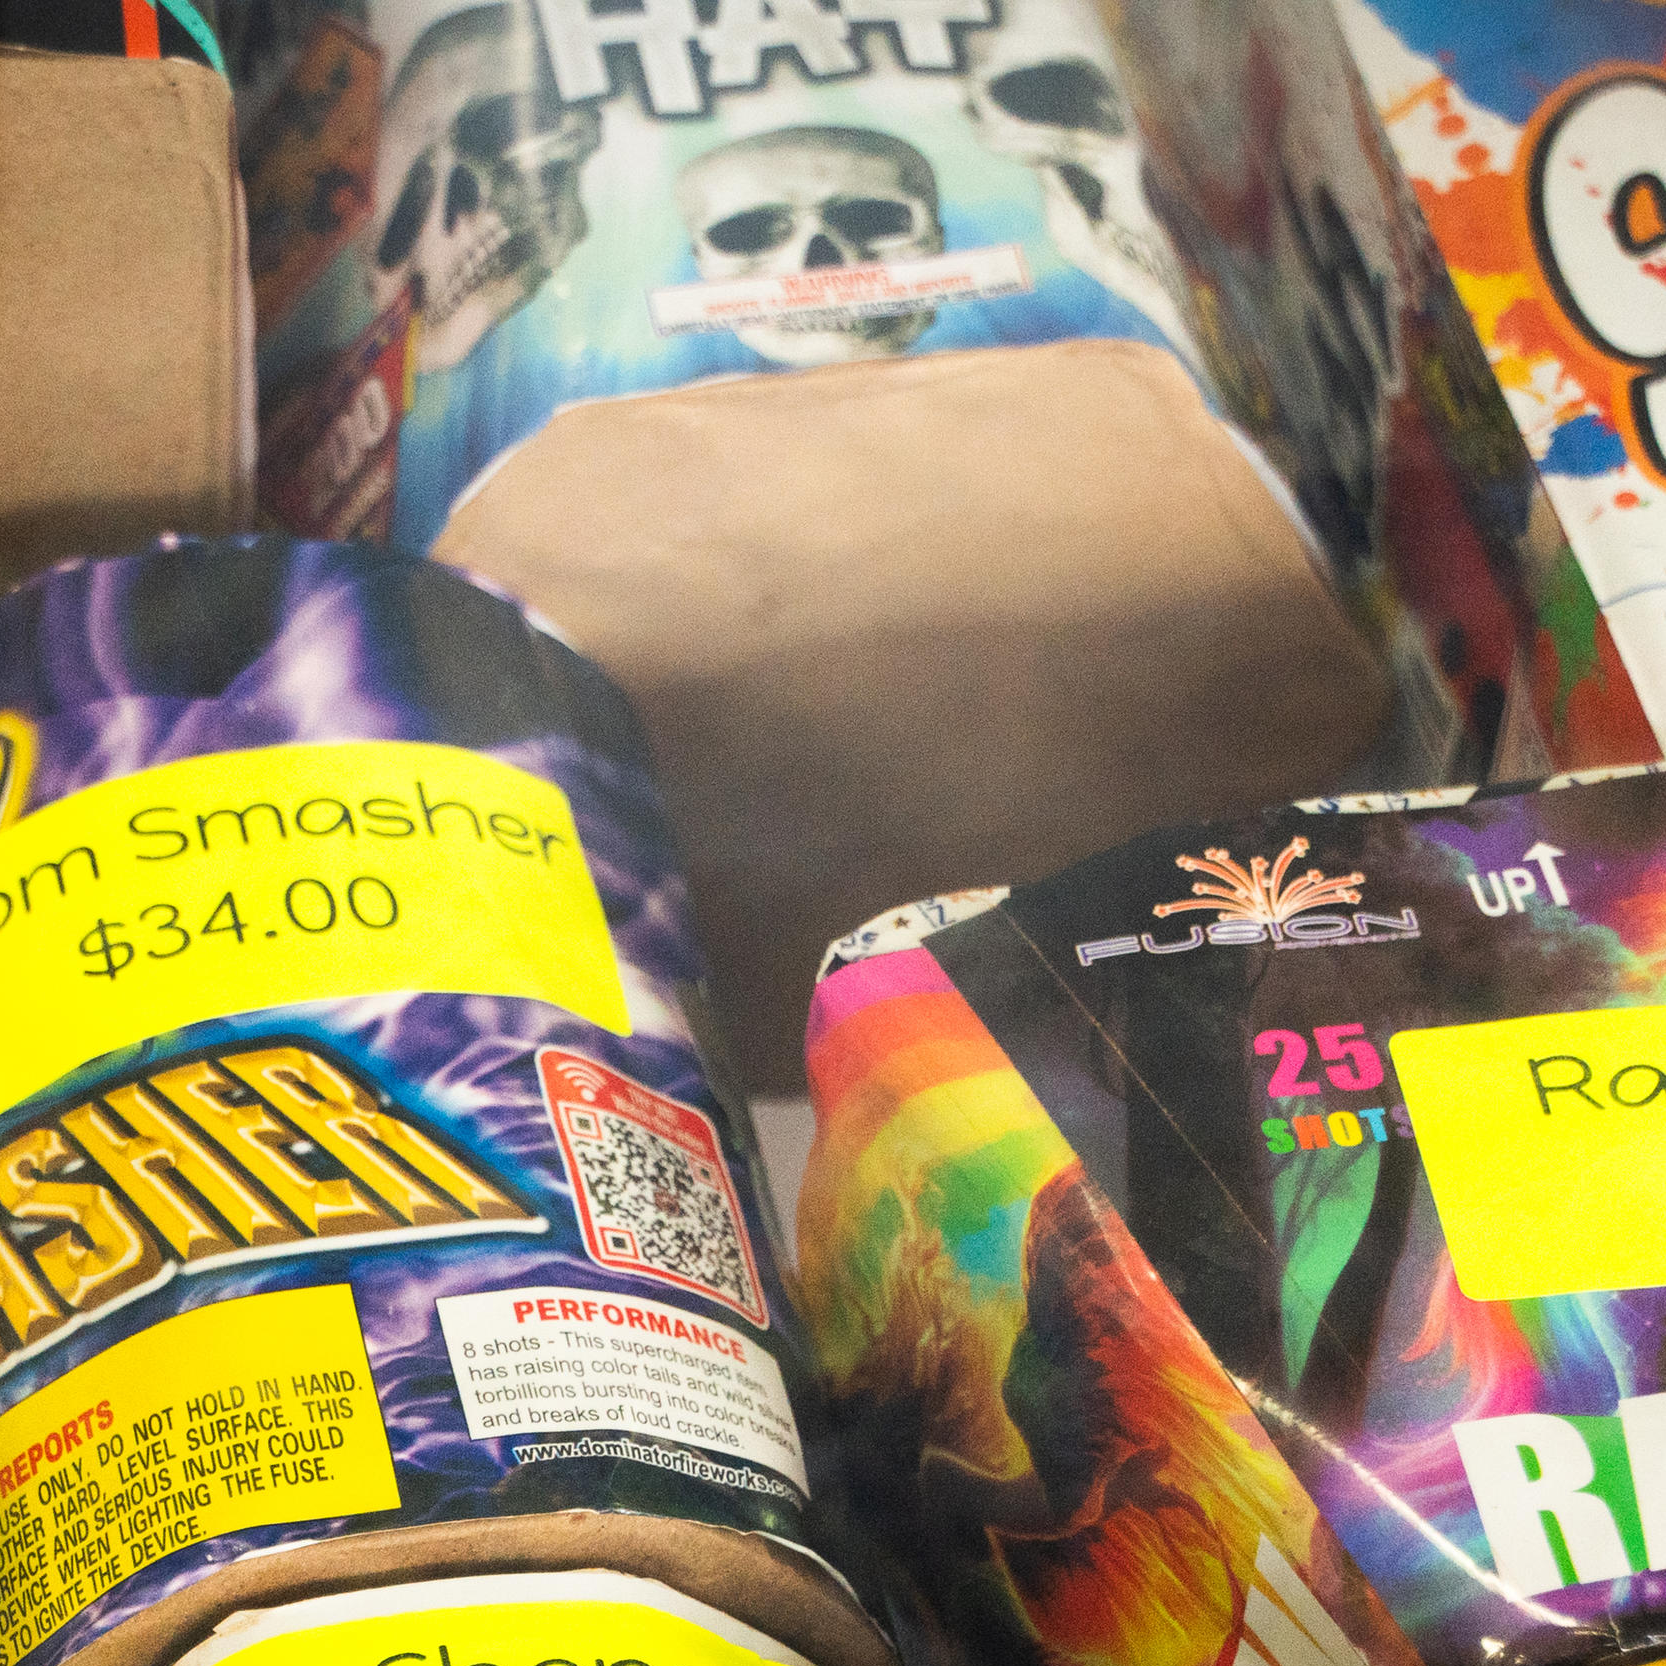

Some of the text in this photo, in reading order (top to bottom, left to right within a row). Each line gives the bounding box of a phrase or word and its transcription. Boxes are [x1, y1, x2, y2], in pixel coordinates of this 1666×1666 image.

[127, 780, 566, 869] Smasher
[78, 875, 400, 980] $34.00
[1467, 870, 1537, 920] UP
[1075, 903, 1421, 968] FUSION
[1253, 1022, 1385, 1098] 25
[462, 1331, 732, 1382] 8 shots This supercharged
[512, 1298, 749, 1365] PERFORMANCE
[468, 1364, 509, 1383] has
[514, 1354, 585, 1378] raising
[590, 1355, 638, 1376] color
[644, 1362, 682, 1388] tails
[686, 1374, 720, 1398] and
[474, 1380, 578, 1405] torbillions
[582, 1379, 663, 1409] bursting
[666, 1390, 701, 1415] into
[703, 1399, 746, 1428] color
[97, 1434, 124, 1467] DO
[133, 1407, 176, 1446] NOT
[186, 1386, 246, 1424] HOLD
[257, 1377, 281, 1402] IN
[292, 1369, 363, 1398] HAND.
[481, 1403, 746, 1450] and breaks of loud crackle.
[52, 1483, 109, 1527] HARD,
[118, 1446, 178, 1486] LEVEL
[185, 1408, 294, 1450] SURFACE.
[306, 1396, 355, 1424] THIS
[54, 1522, 90, 1562] AND
[95, 1471, 173, 1534] SERIOUS
[181, 1439, 261, 1483] INJURY
[267, 1425, 346, 1458] COULD
[58, 1538, 113, 1585] WHEN
[119, 1483, 212, 1546] LIGHTING
[221, 1470, 266, 1500] THE
[271, 1456, 336, 1489] FUSE.
[10, 1620, 33, 1657] TO
[34, 1580, 89, 1640] IGNITE
[87, 1560, 124, 1596] THE
[130, 1516, 208, 1566] DEVICE.
